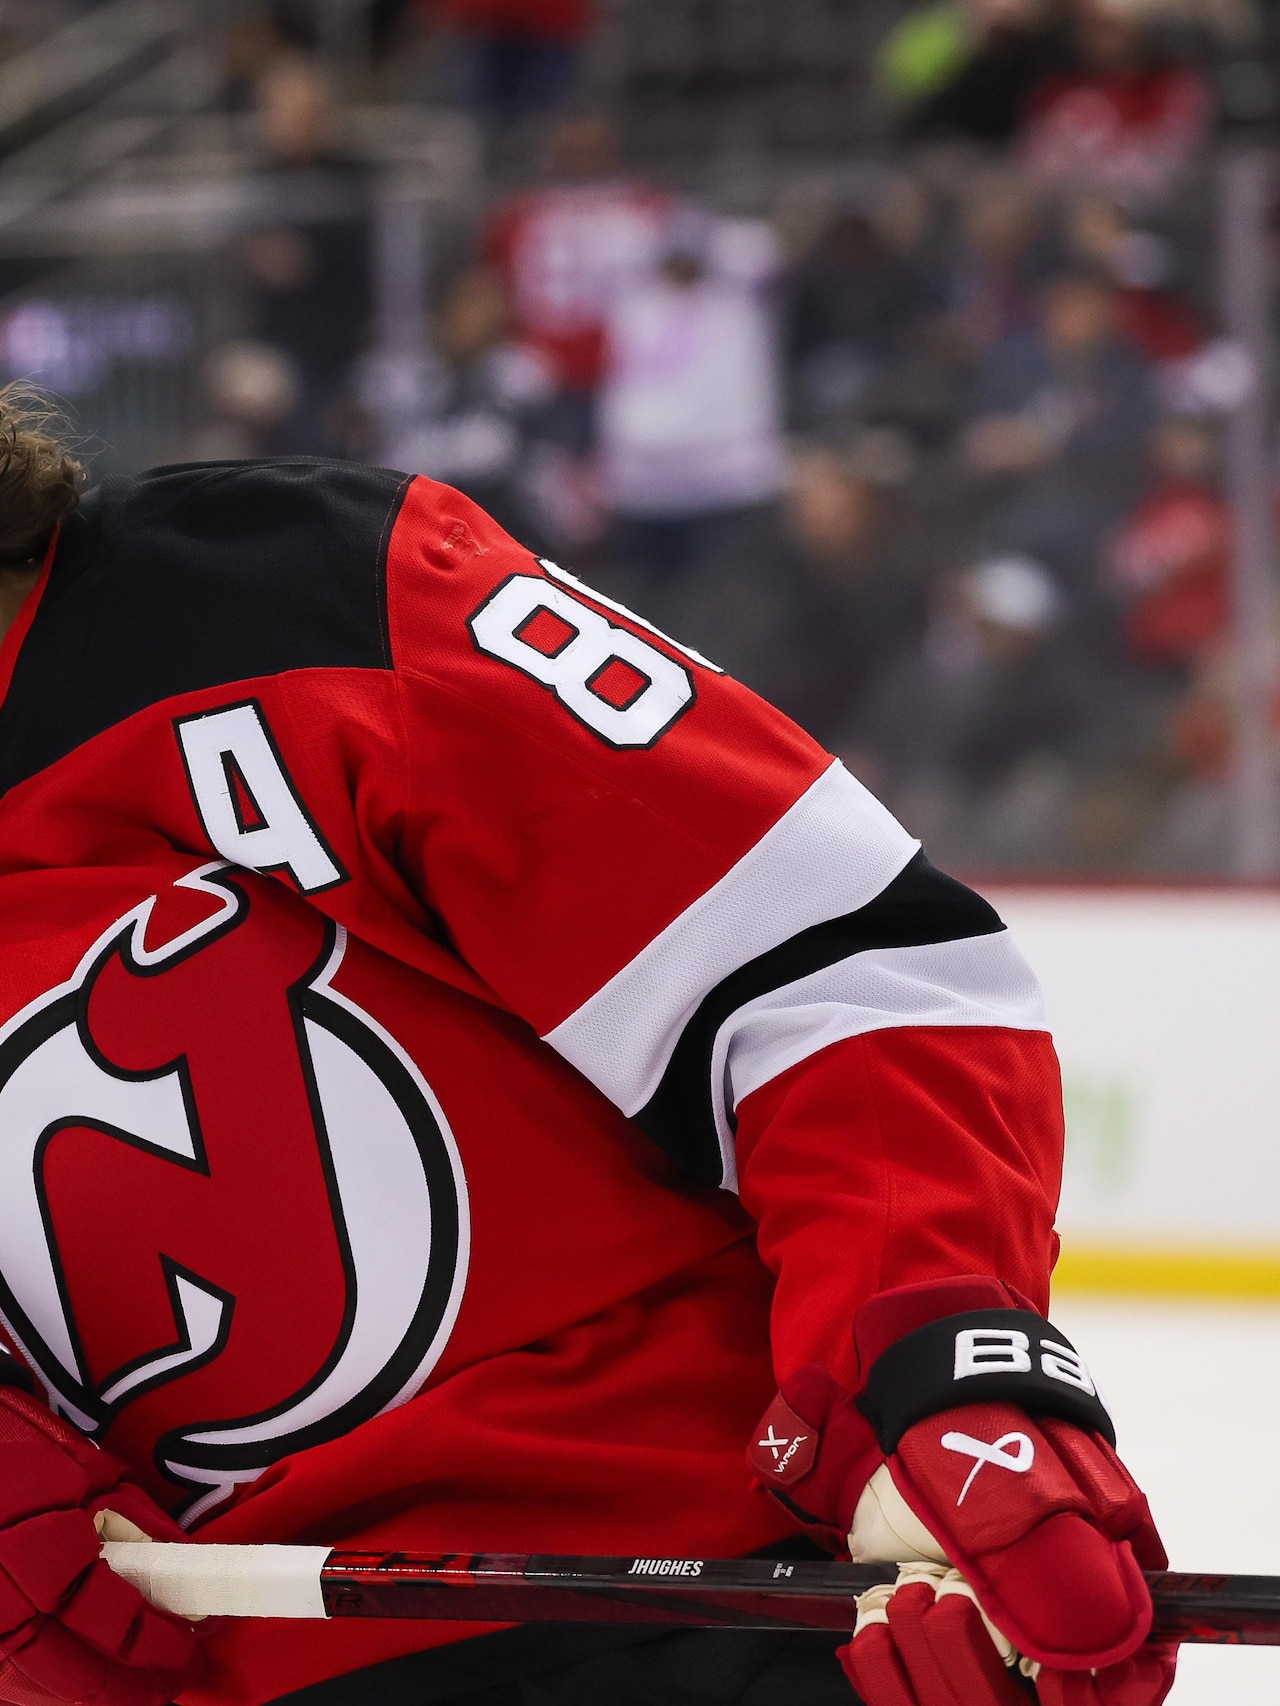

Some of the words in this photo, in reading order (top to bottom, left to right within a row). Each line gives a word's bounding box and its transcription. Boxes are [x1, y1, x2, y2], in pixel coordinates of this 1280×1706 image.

[465, 557, 725, 751] 8
[172, 697, 352, 896] A
[773, 1435, 808, 1473] VAPOR
[628, 1558, 704, 1577] JHUGHES
